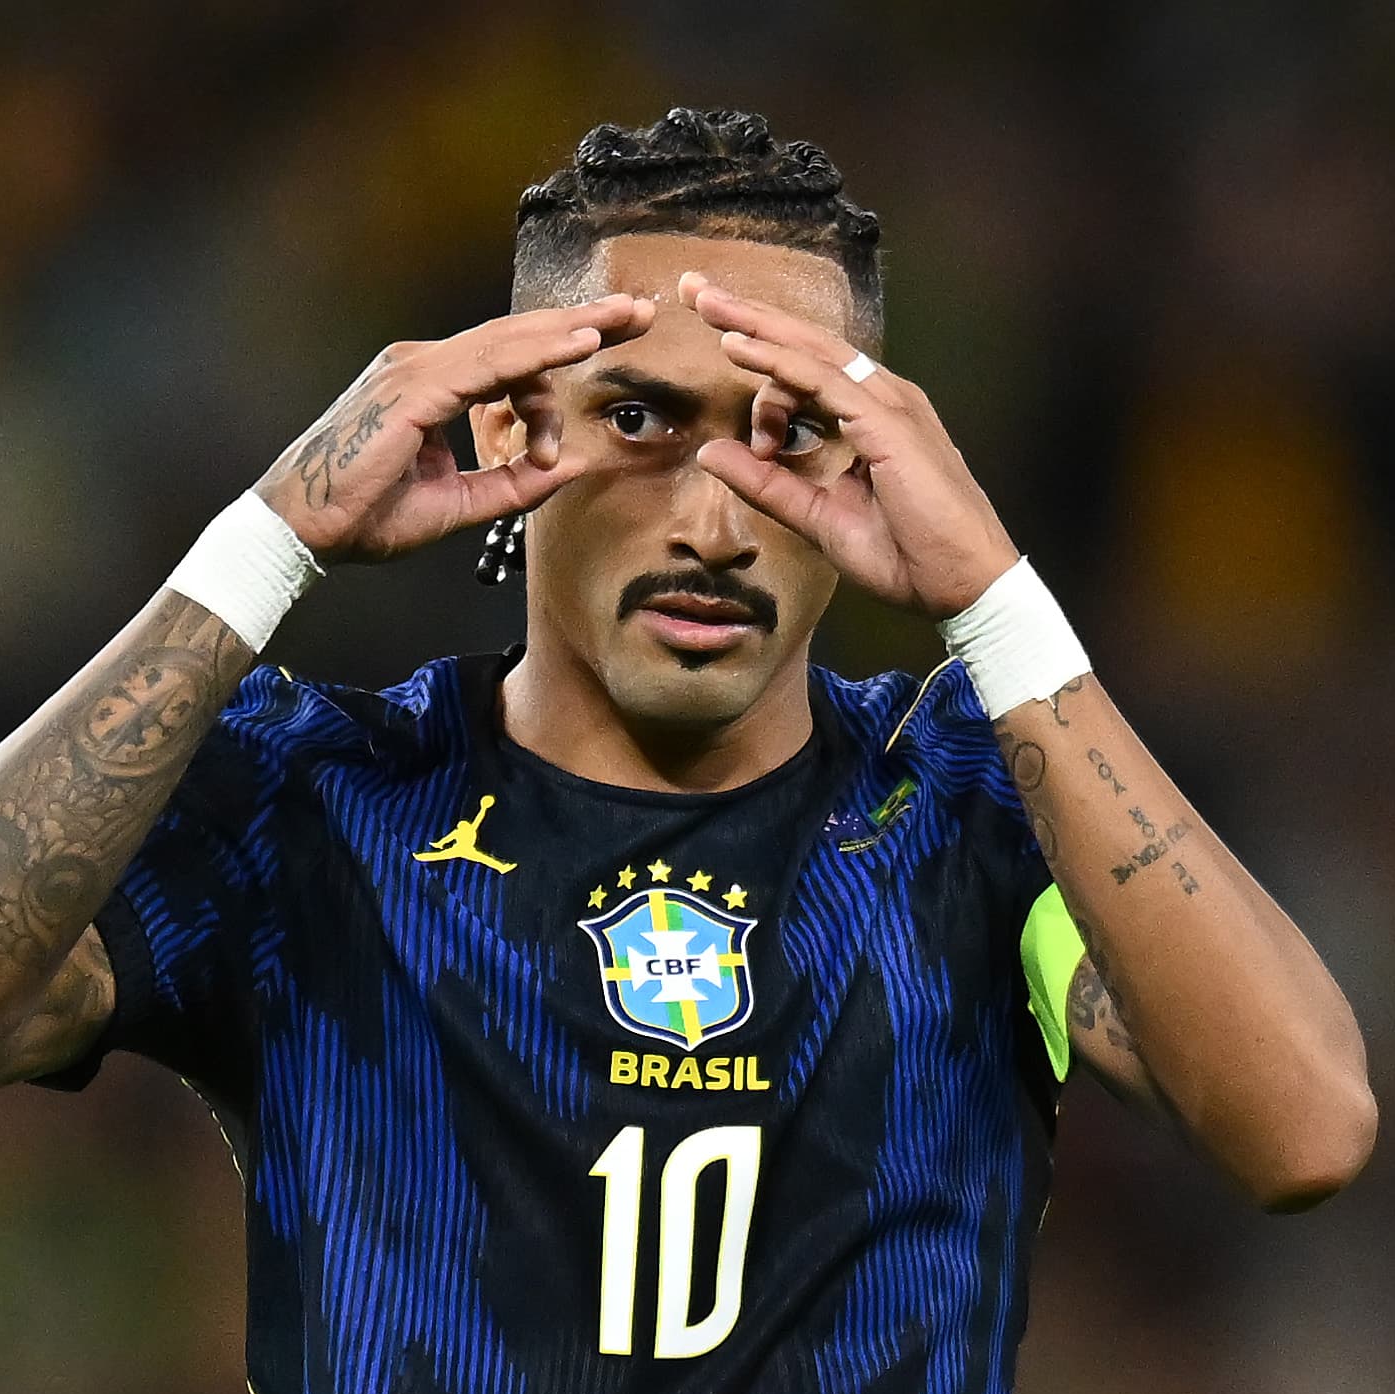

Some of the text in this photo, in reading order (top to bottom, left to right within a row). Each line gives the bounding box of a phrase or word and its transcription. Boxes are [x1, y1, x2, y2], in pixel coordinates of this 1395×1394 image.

[1087, 747, 1127, 797] YOU
[646, 955, 703, 976] CBF
[609, 1050, 772, 1091] BRASIL
[588, 1125, 762, 1359] 10
